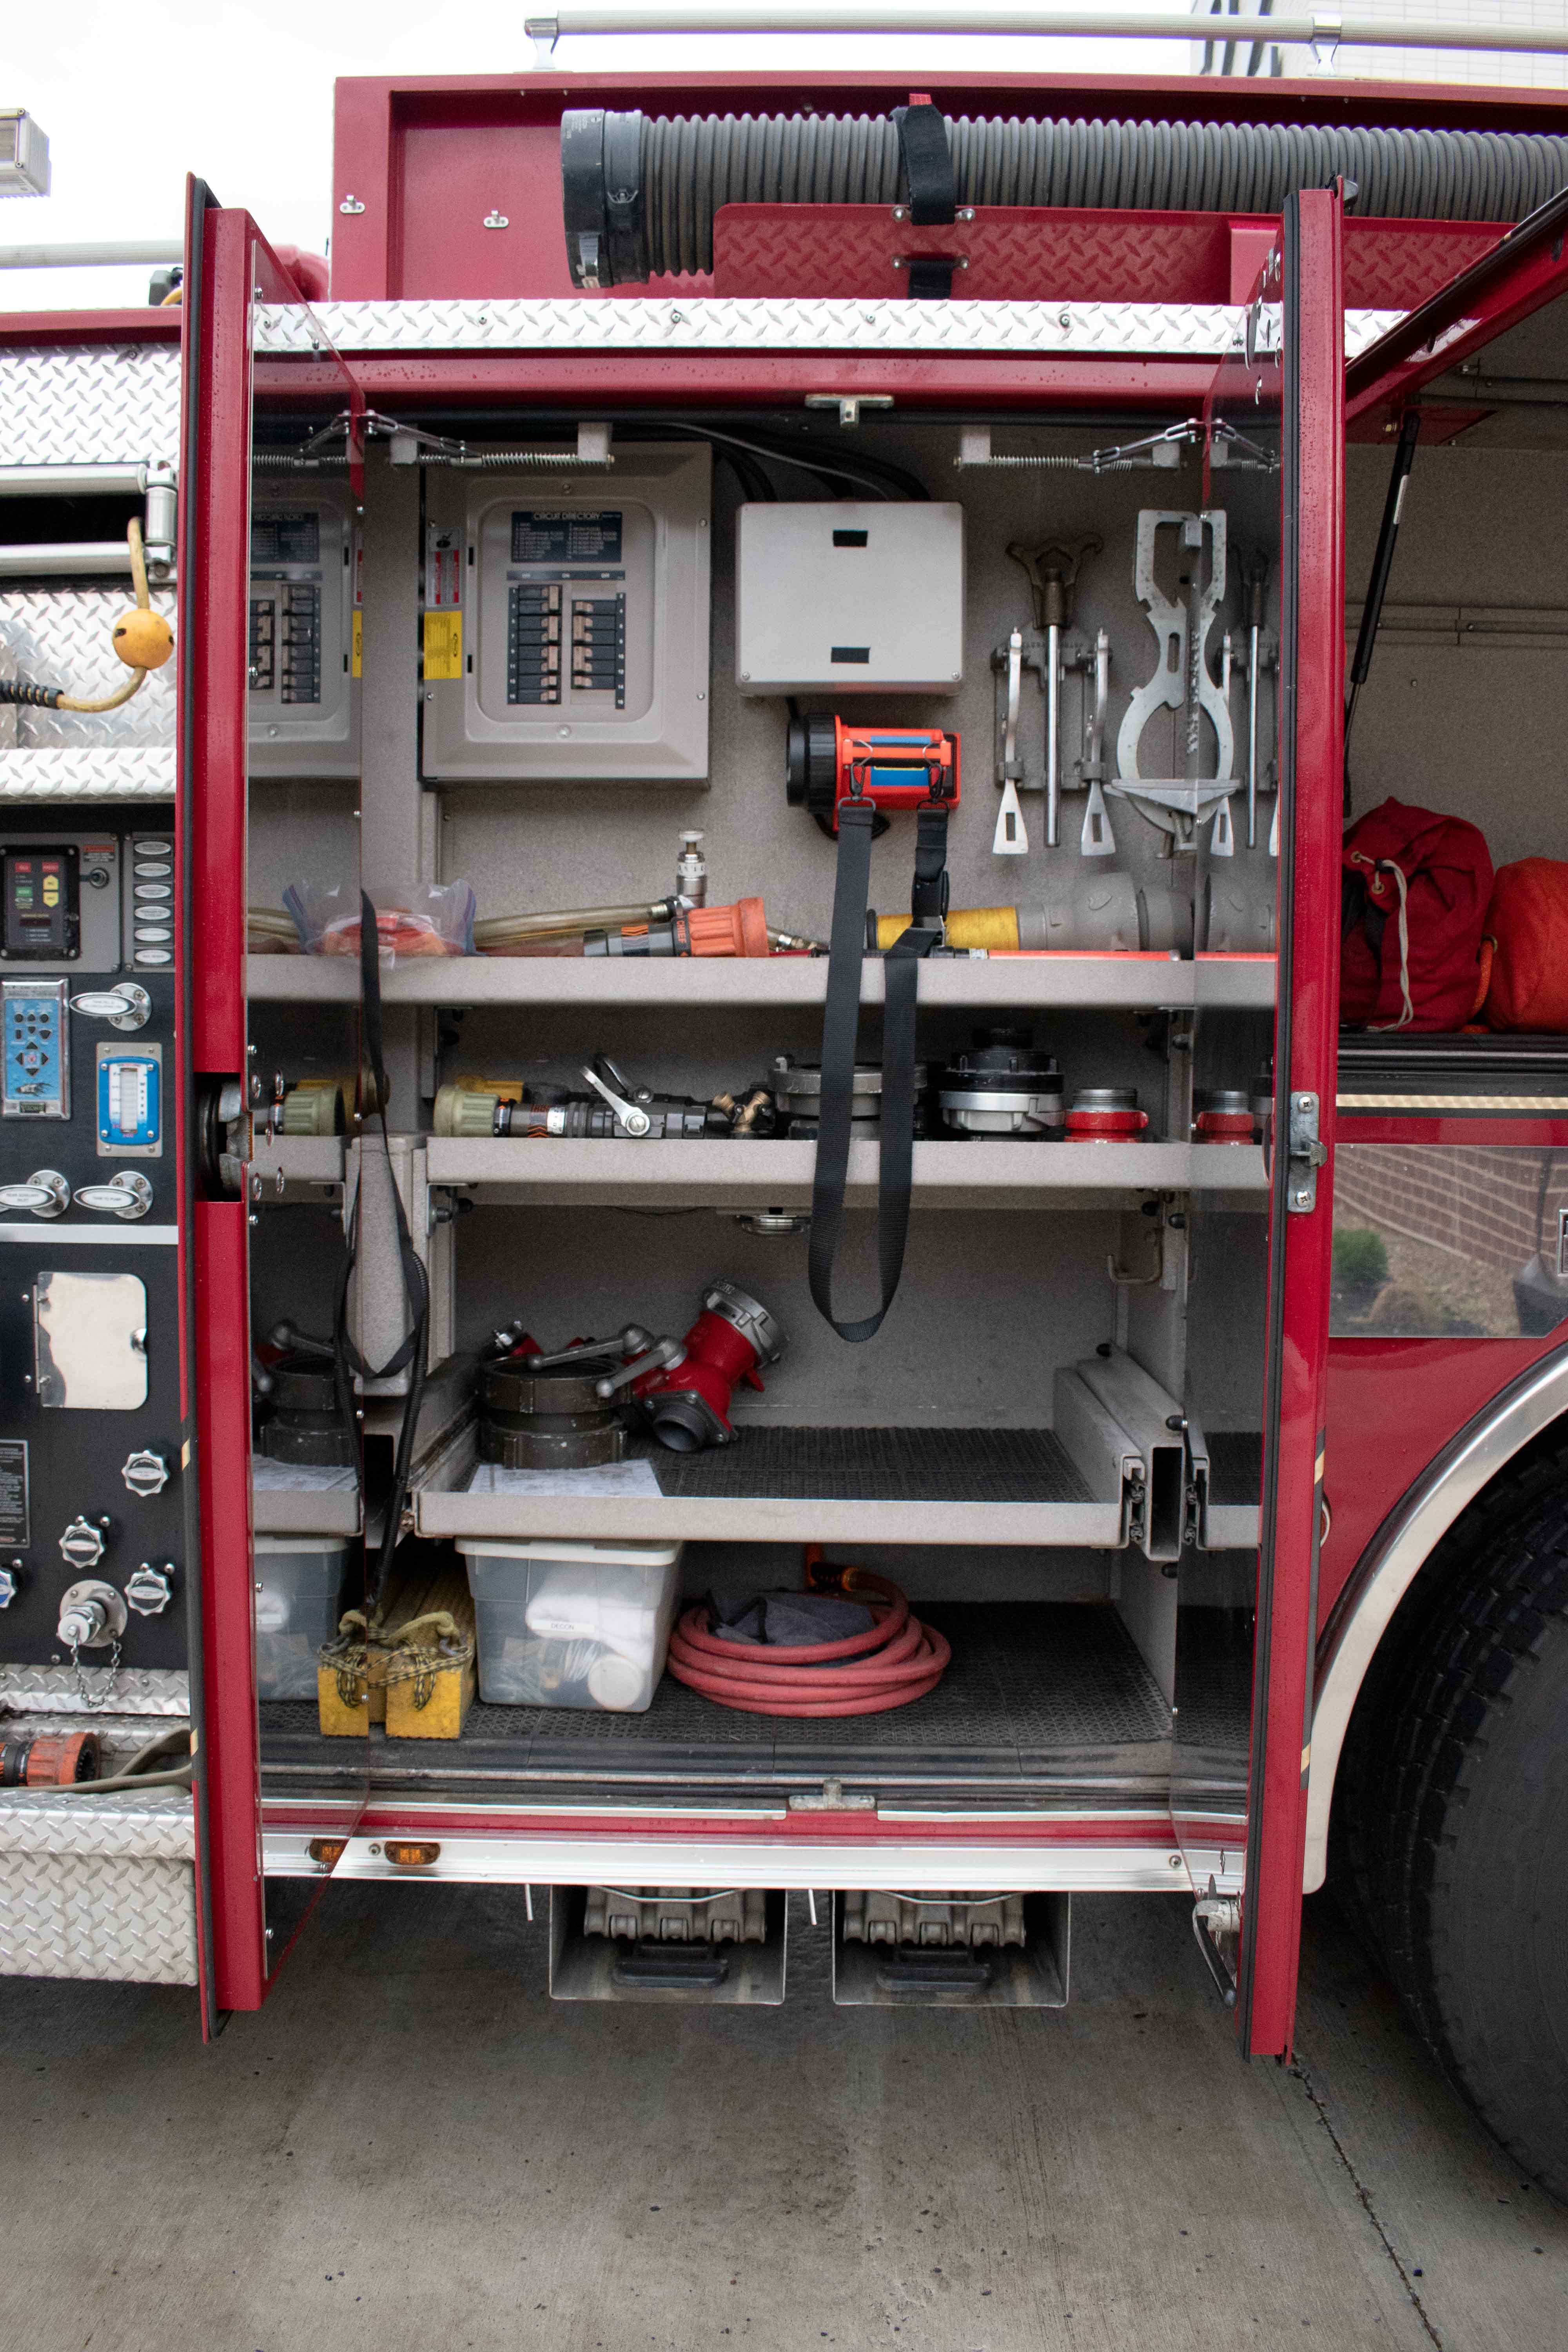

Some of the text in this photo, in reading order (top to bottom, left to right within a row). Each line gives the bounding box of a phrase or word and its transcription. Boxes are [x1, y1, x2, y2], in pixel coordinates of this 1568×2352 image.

[533, 512, 561, 521] CIRCUIT
[562, 512, 600, 521] DIRECTORY
[677, 920, 686, 943] CHIEF
